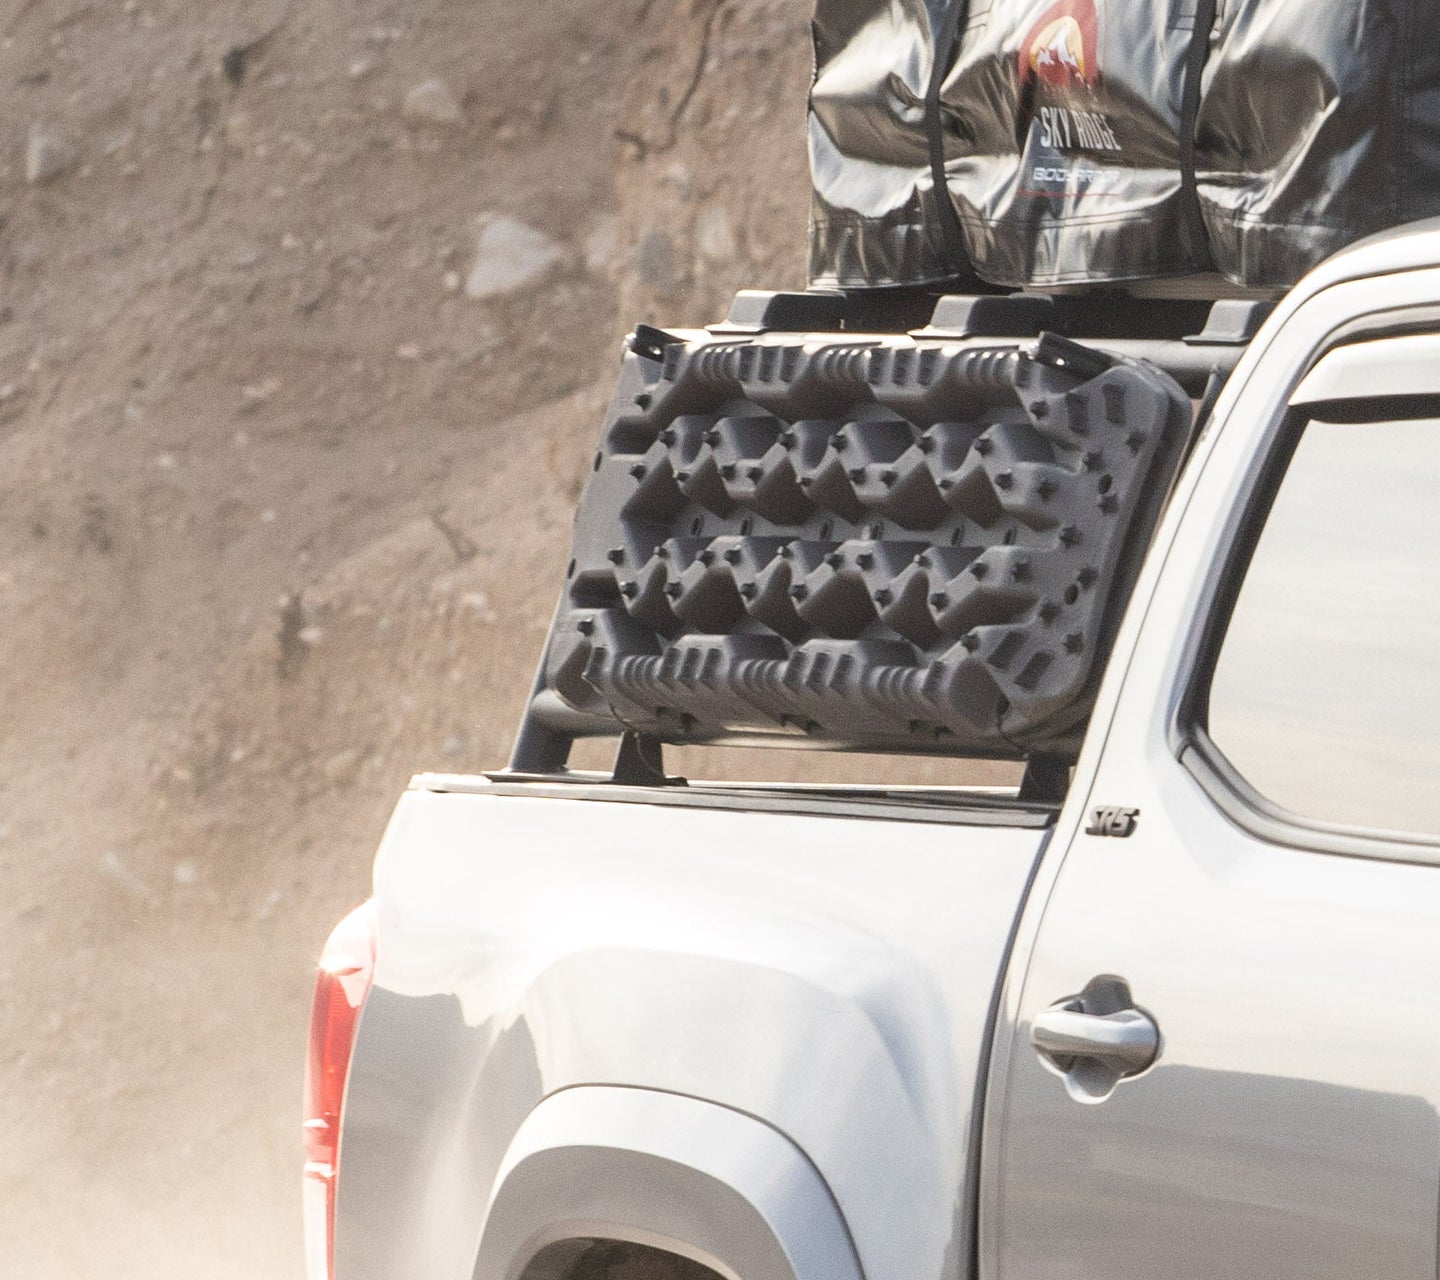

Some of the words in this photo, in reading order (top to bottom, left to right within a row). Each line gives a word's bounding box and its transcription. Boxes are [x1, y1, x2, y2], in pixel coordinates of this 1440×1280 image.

[1040, 106, 1072, 149] SKY
[1071, 109, 1122, 151] RIDGE
[1085, 806, 1141, 838] SR5
